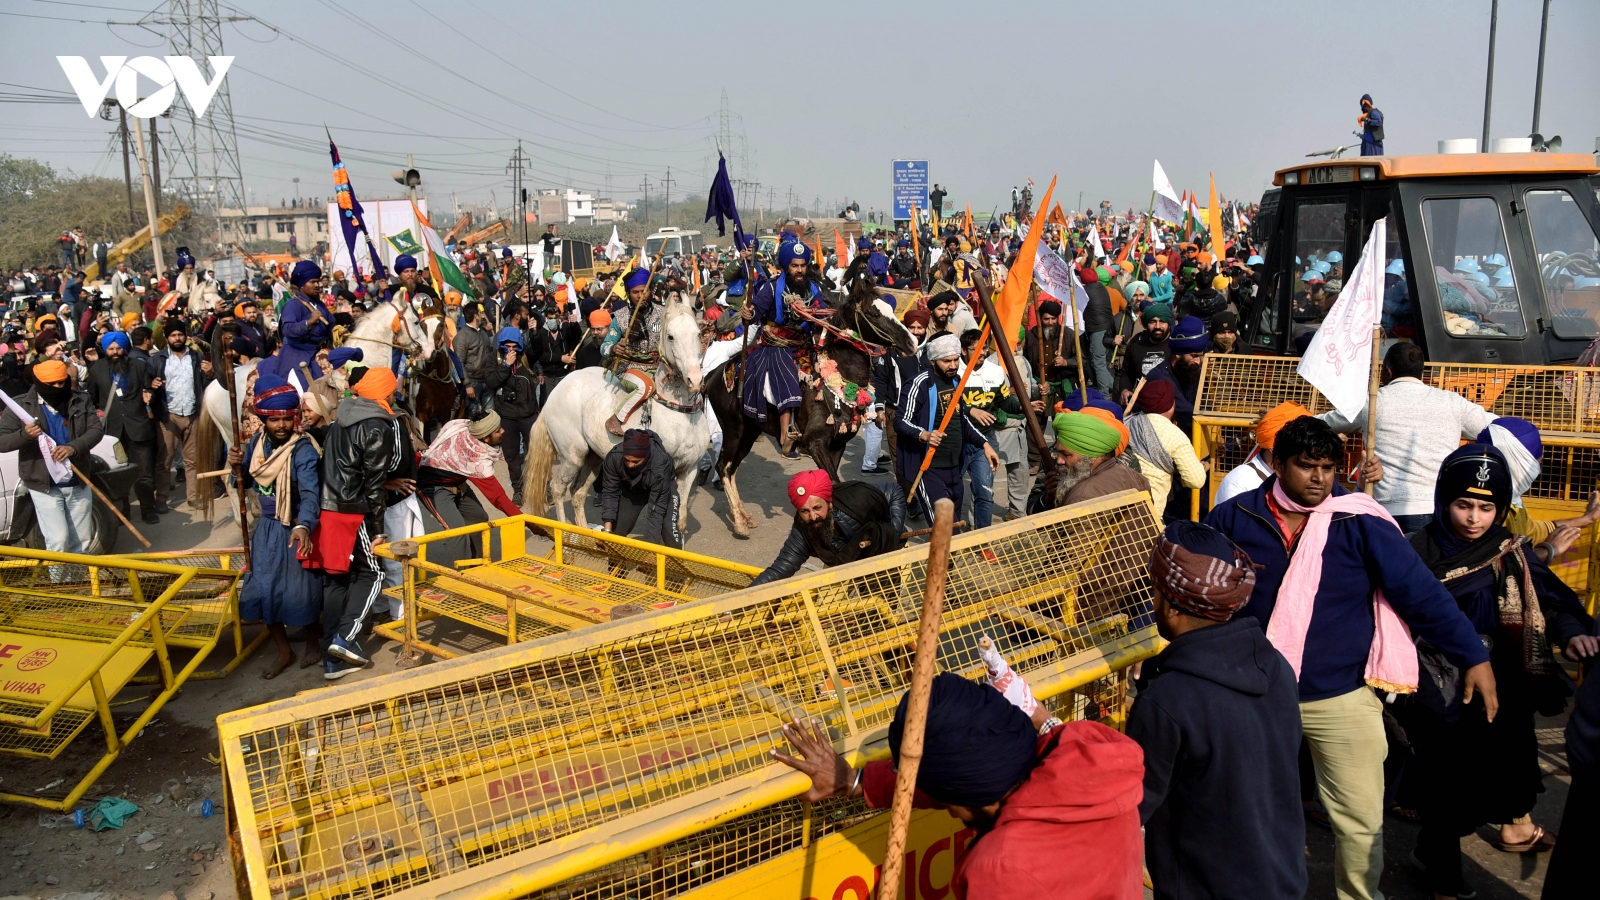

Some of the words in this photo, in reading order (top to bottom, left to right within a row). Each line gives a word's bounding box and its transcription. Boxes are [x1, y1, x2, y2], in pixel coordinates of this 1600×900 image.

[1309, 167, 1333, 184] ACE
[3, 680, 46, 695] VIHAR
[488, 763, 607, 804] DELHI
